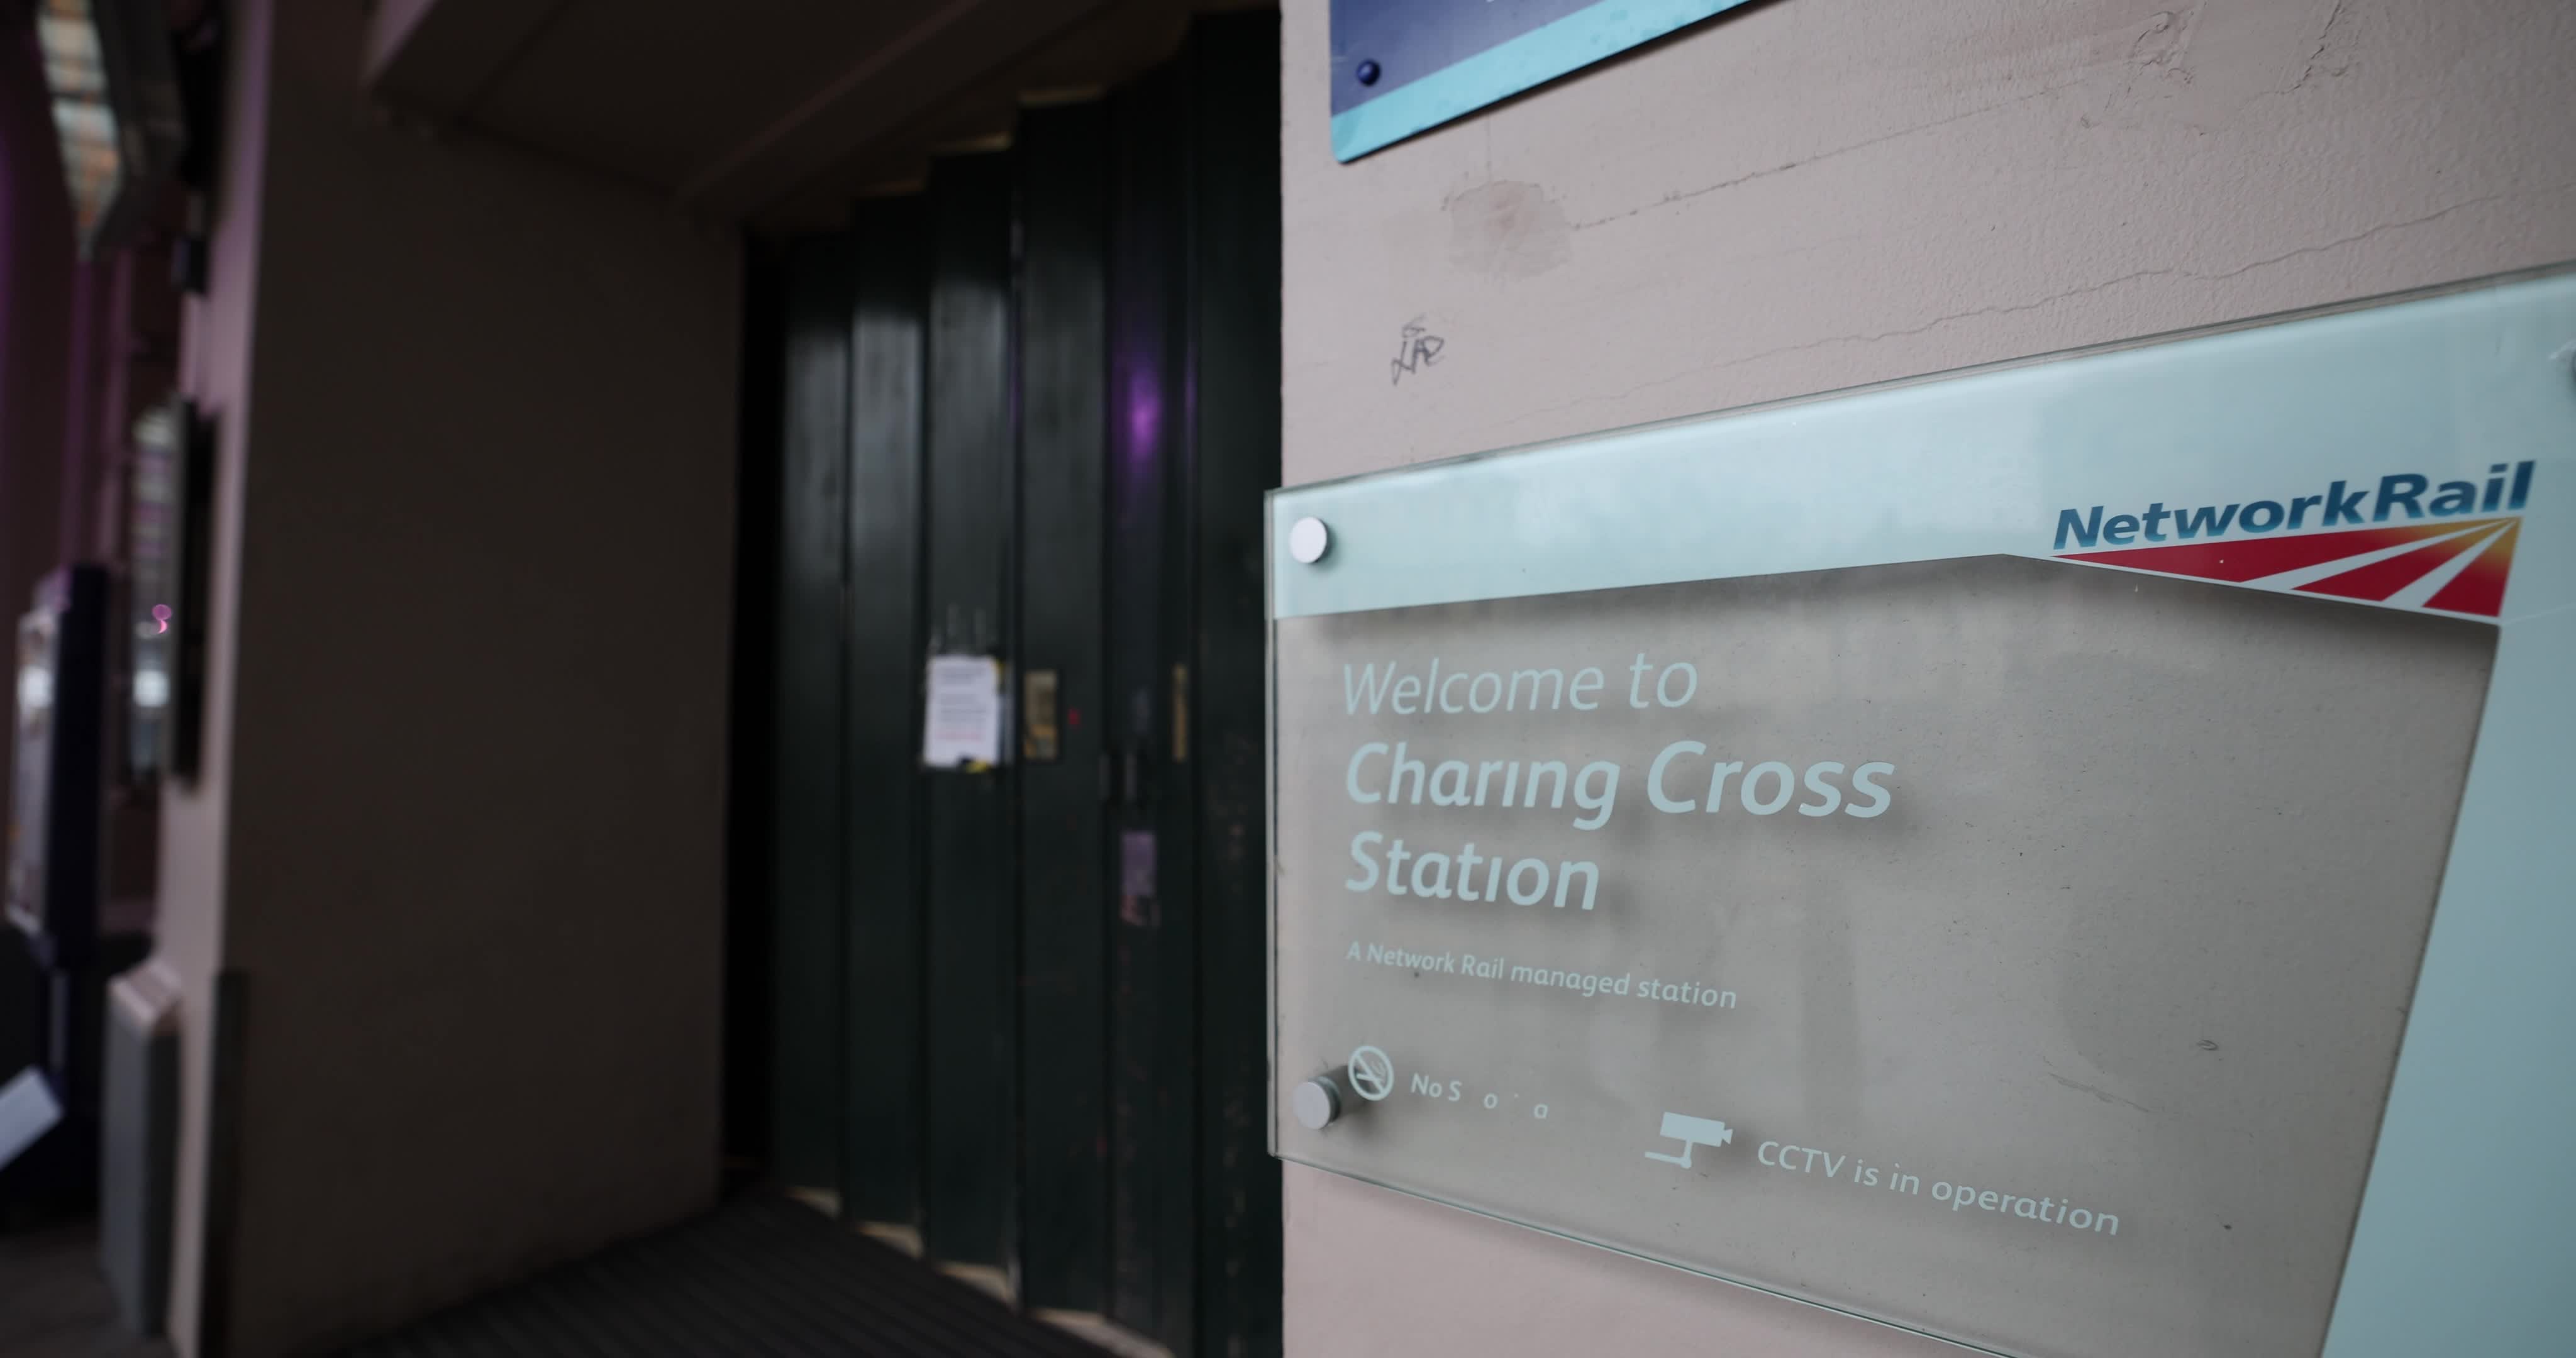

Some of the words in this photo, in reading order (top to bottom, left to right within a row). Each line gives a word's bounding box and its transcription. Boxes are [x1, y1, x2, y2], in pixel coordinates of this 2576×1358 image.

[2052, 460, 2536, 551] NetworkRail
[1343, 657, 1604, 715] Welcome
[1629, 652, 1698, 709] to
[1646, 740, 1896, 819] Cross
[1345, 941, 1362, 961] A
[1367, 944, 1455, 974] Network
[1460, 954, 1504, 980] Rail
[1510, 965, 1631, 998] managed
[1638, 978, 1737, 1009] station
[1411, 1073, 1442, 1098] No
[1757, 1140, 1846, 1178] CCTV
[1853, 1159, 1879, 1186] is
[1889, 1163, 1920, 1195] in
[1931, 1180, 2121, 1236] operation
